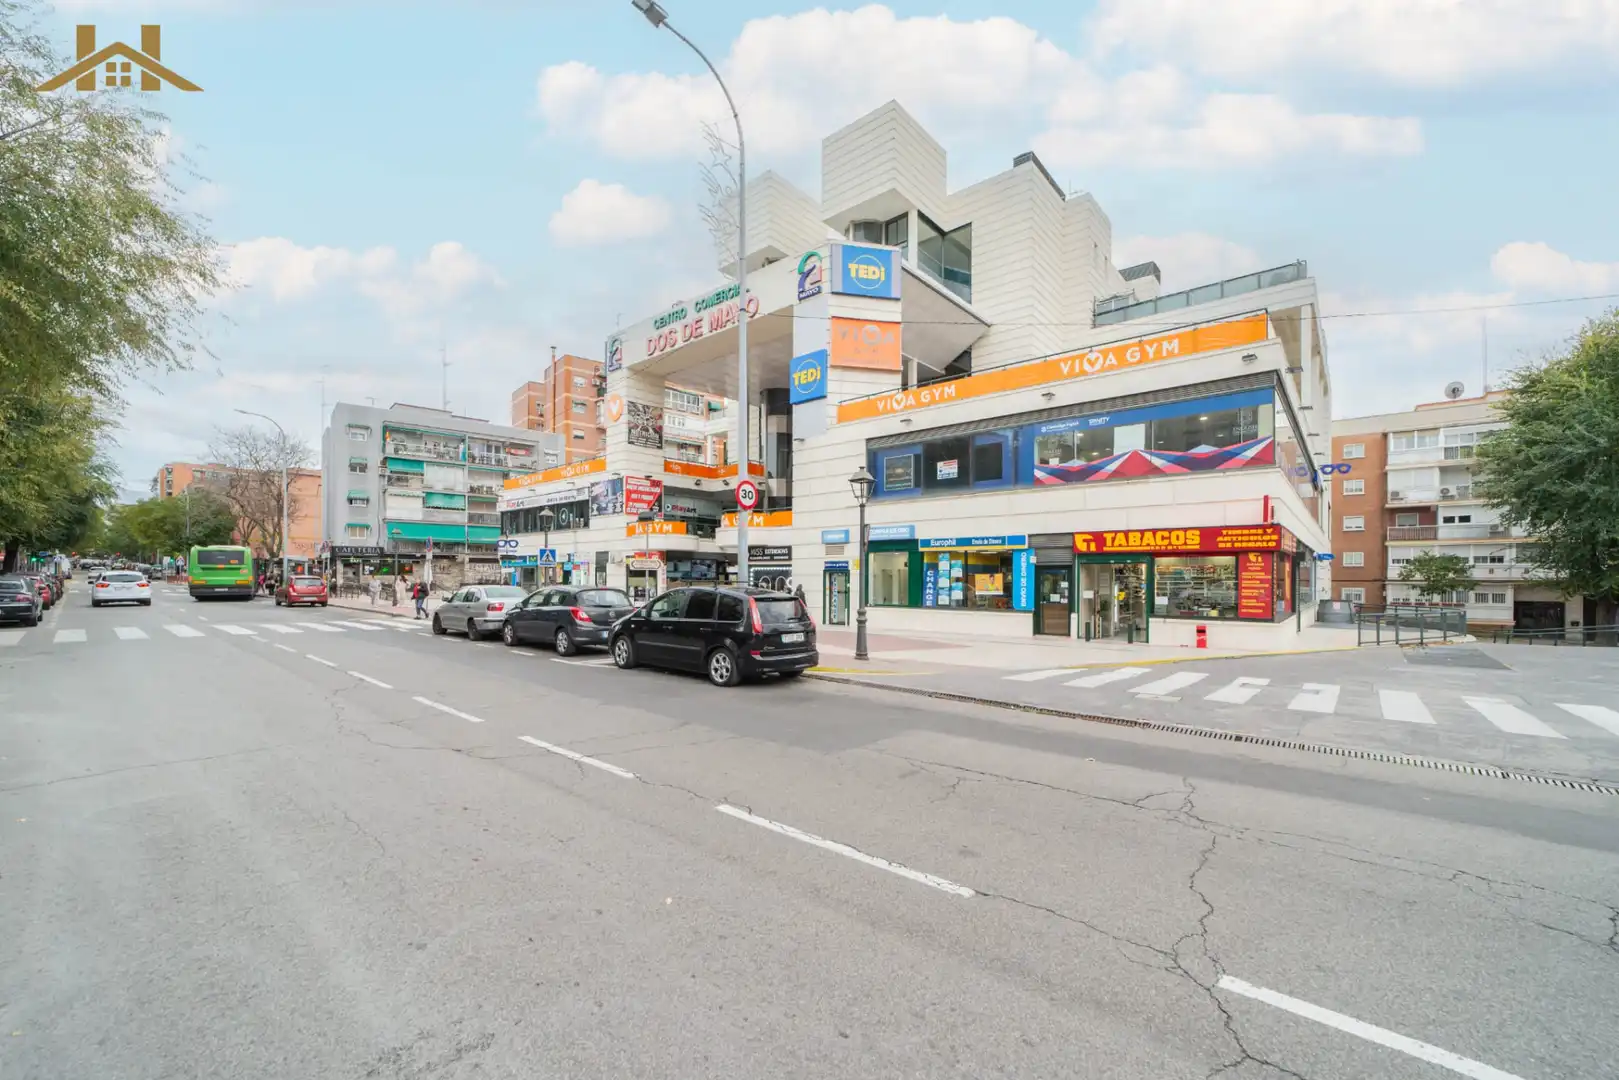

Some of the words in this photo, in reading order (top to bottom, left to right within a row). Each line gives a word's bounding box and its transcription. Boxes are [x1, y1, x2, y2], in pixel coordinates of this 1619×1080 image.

[848, 263, 885, 281] TEDi
[653, 307, 687, 330] CENTRO
[695, 283, 748, 313] COMERCI
[645, 328, 678, 357] DOS
[681, 316, 703, 343] DE
[1125, 338, 1180, 363] GYM
[792, 365, 821, 387] TEDi
[920, 384, 956, 403] GYM
[740, 488, 754, 501] 30
[930, 538, 957, 547] Europhil
[1103, 530, 1201, 546] TABACOS
[926, 570, 934, 607] CHANGE
